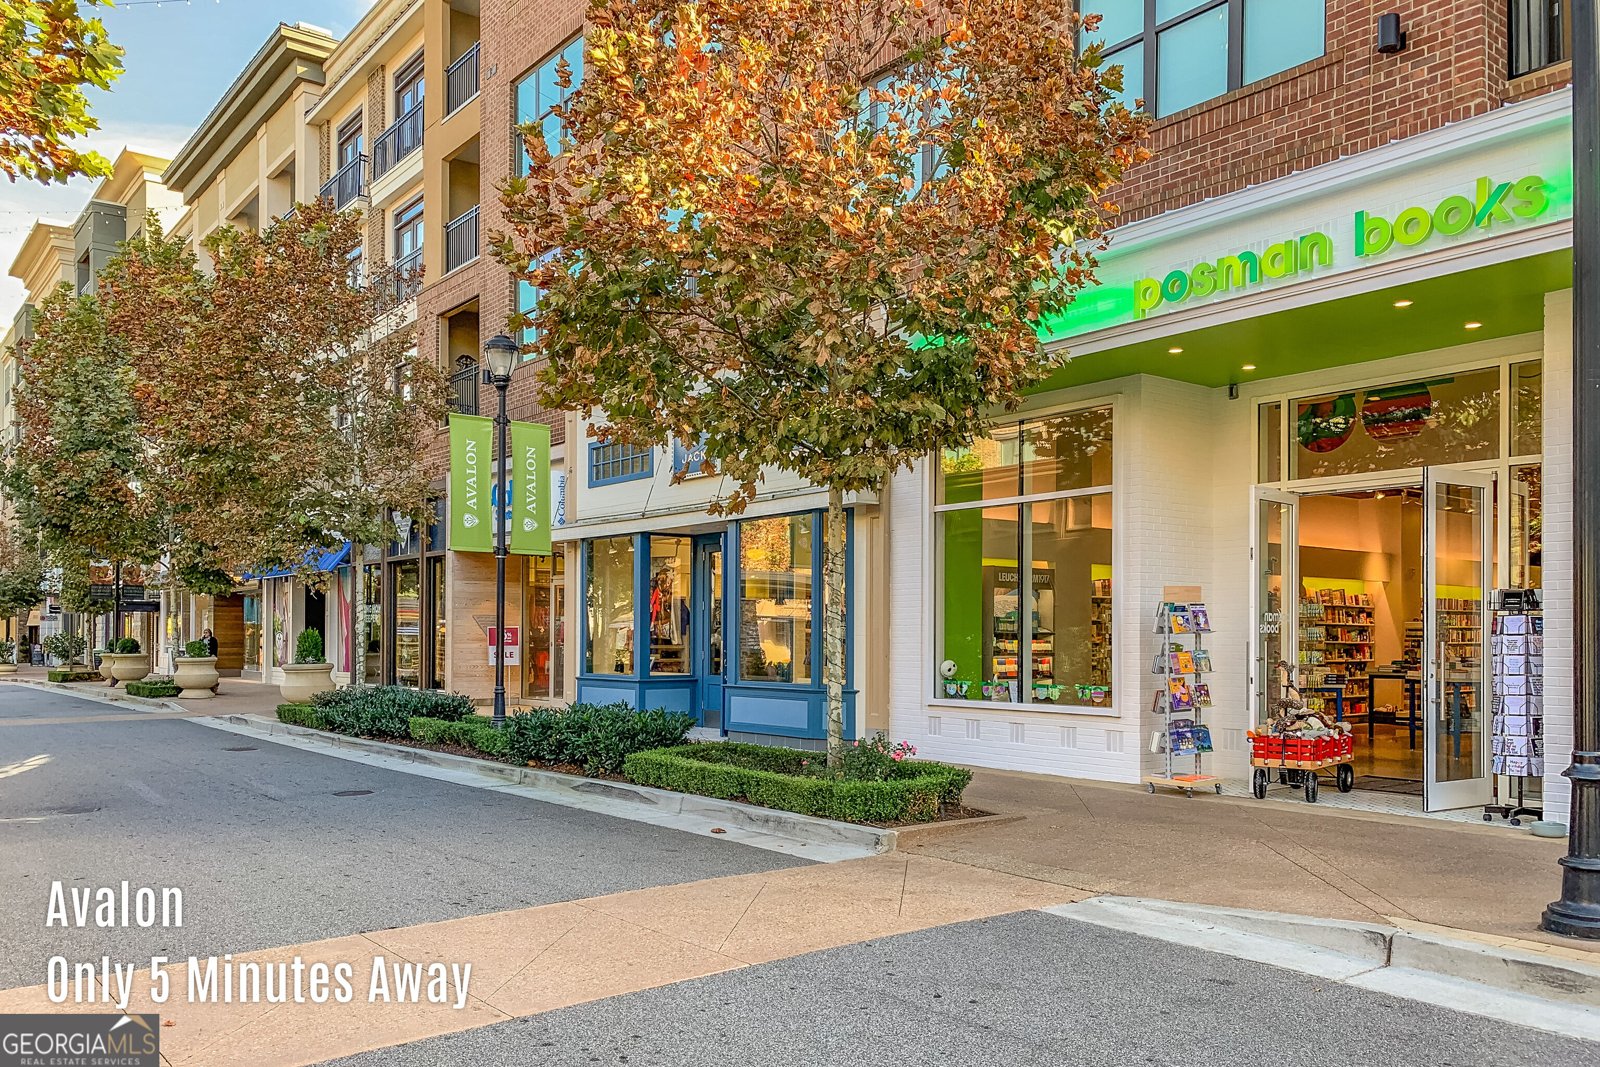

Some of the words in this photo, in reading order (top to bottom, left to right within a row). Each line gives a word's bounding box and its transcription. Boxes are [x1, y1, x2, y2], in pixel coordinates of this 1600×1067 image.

[1134, 232, 1334, 319] posman
[1354, 175, 1549, 257] books
[466, 439, 477, 510] AVALON
[526, 446, 537, 514] AVALON
[681, 450, 707, 464] JACK
[557, 475, 566, 516] Columbia
[493, 651, 515, 659] SLE
